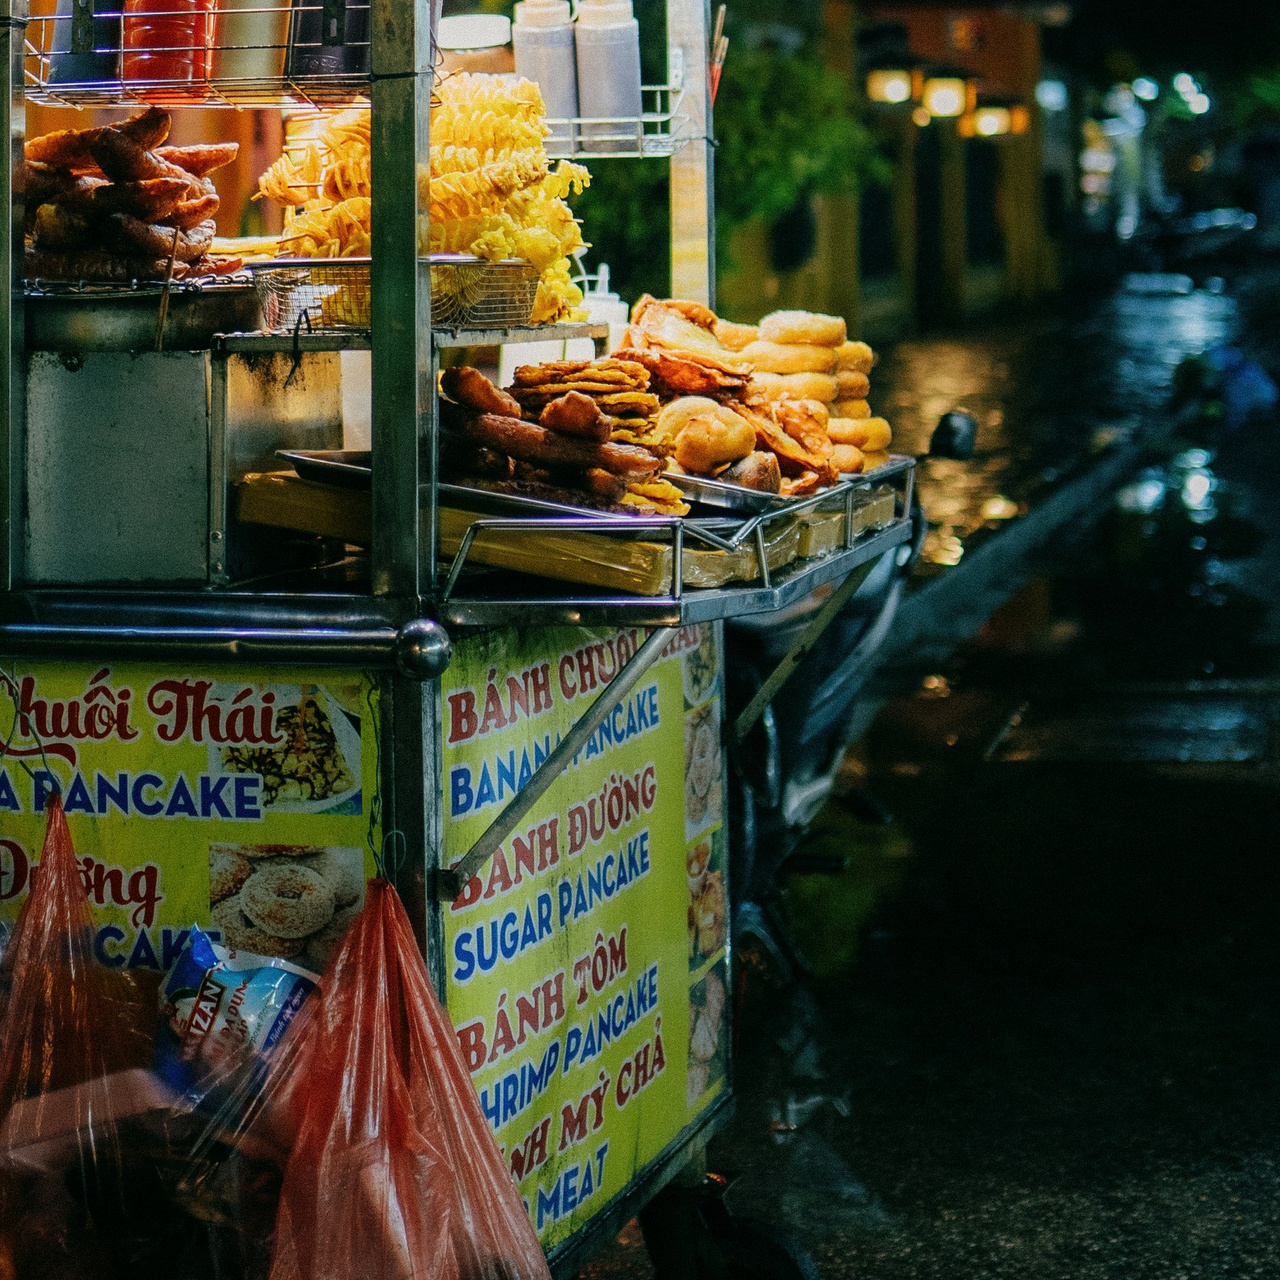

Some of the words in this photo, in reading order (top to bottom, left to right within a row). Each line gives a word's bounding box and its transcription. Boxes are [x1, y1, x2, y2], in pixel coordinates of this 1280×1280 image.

[147, 678, 286, 745] Thái
[448, 663, 553, 743] BÁNH
[34, 770, 262, 819] PANCAKE
[451, 731, 567, 817] BANAN
[568, 766, 656, 855] ĐƯỜNG
[454, 893, 552, 980] SUGAR
[559, 831, 650, 927] PANCAKE
[186, 981, 222, 1041] IZAN
[457, 972, 566, 1073] BÁNH
[574, 927, 628, 1005] TÔM
[480, 1041, 560, 1129] HRIMP
[564, 966, 657, 1073] PANCAKE
[615, 1016, 665, 1107] CHẢ
[537, 1142, 608, 1230] MEAT
